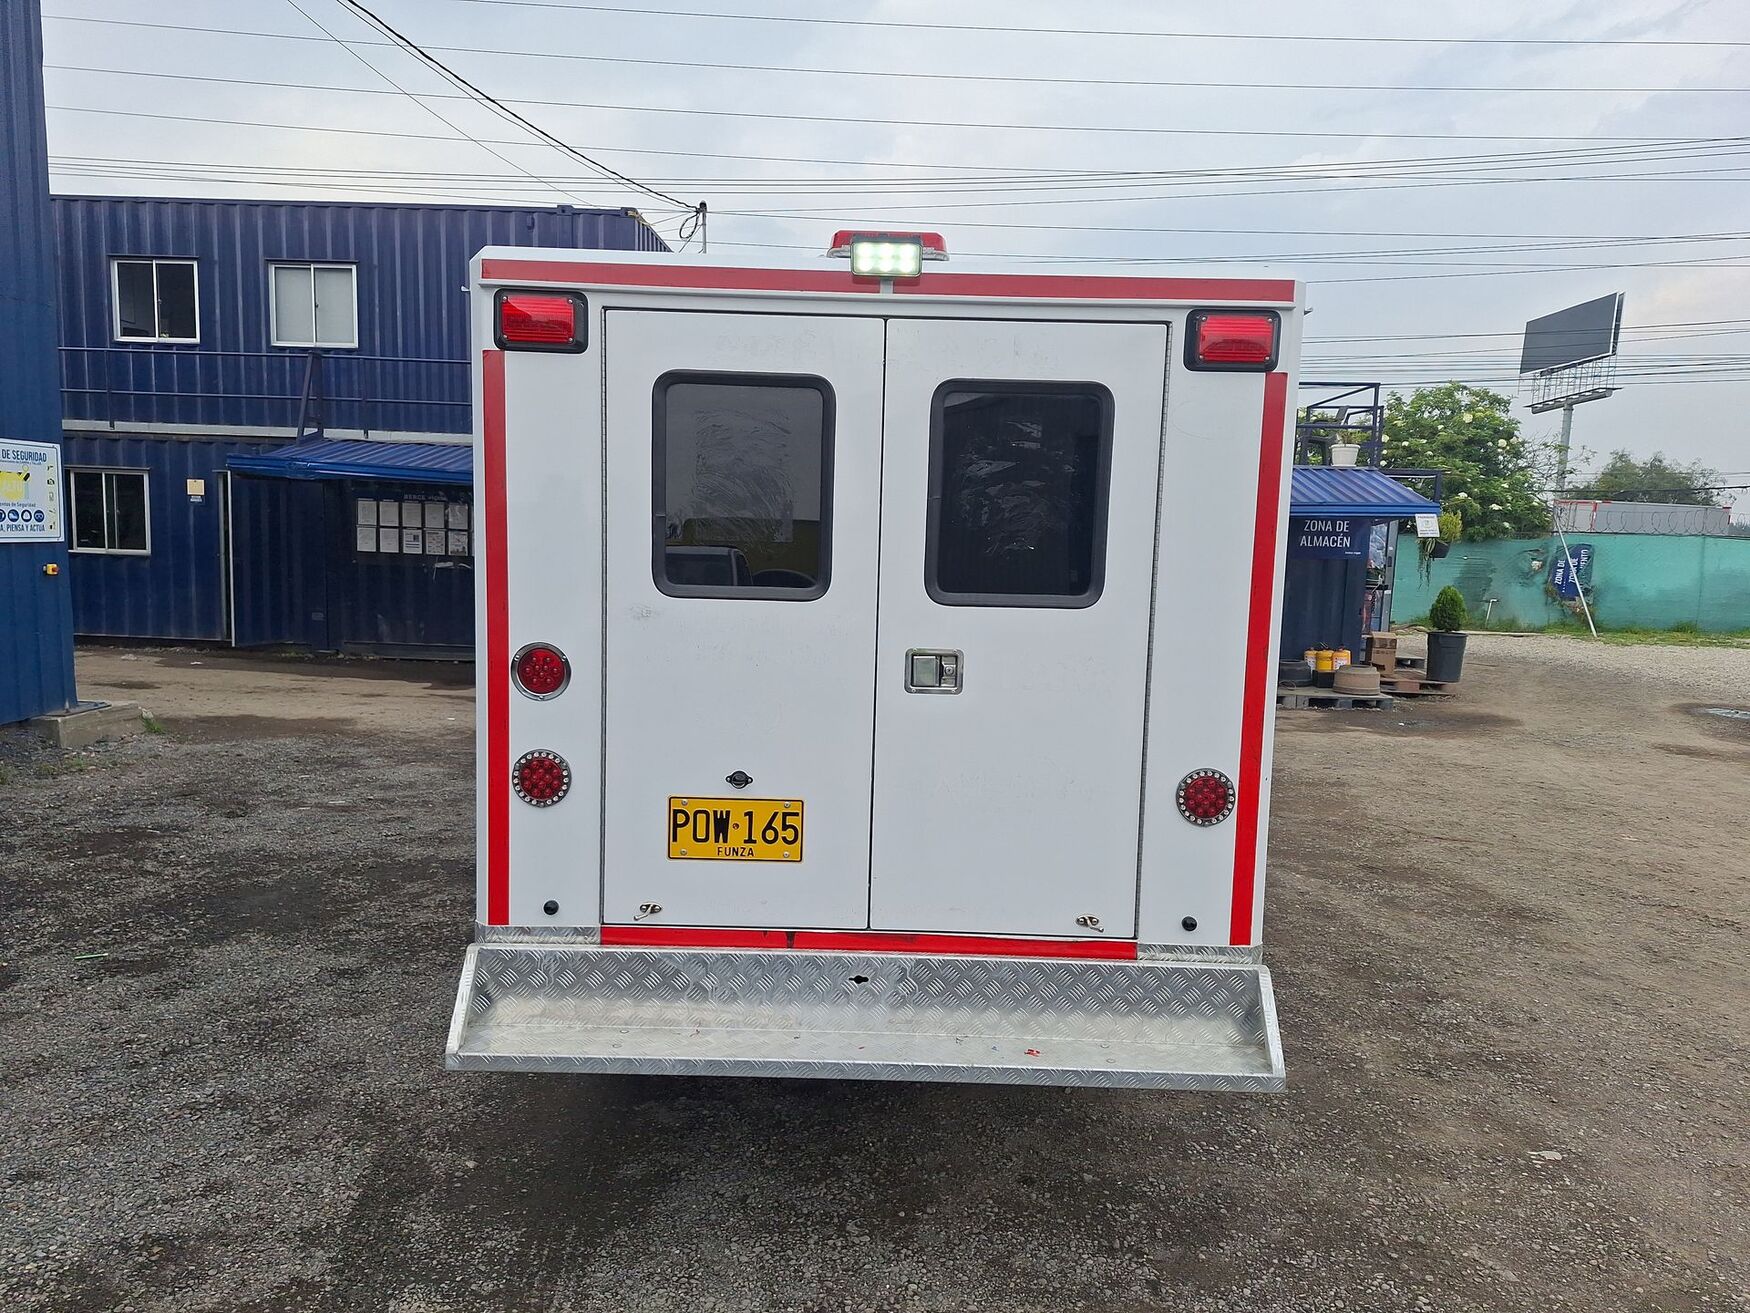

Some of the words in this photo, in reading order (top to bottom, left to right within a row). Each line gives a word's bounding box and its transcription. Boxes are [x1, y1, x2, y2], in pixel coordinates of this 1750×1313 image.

[1, 448, 11, 460] DE
[12, 449, 47, 463] SEGURIDAD
[6, 523, 25, 533] PIENSA
[1304, 519, 1333, 532] ZONA
[1336, 520, 1350, 532] DE
[1299, 533, 1351, 548] ALMACÉN
[671, 808, 731, 844] POW
[743, 810, 800, 846] 165
[717, 846, 755, 857] FUNZA
